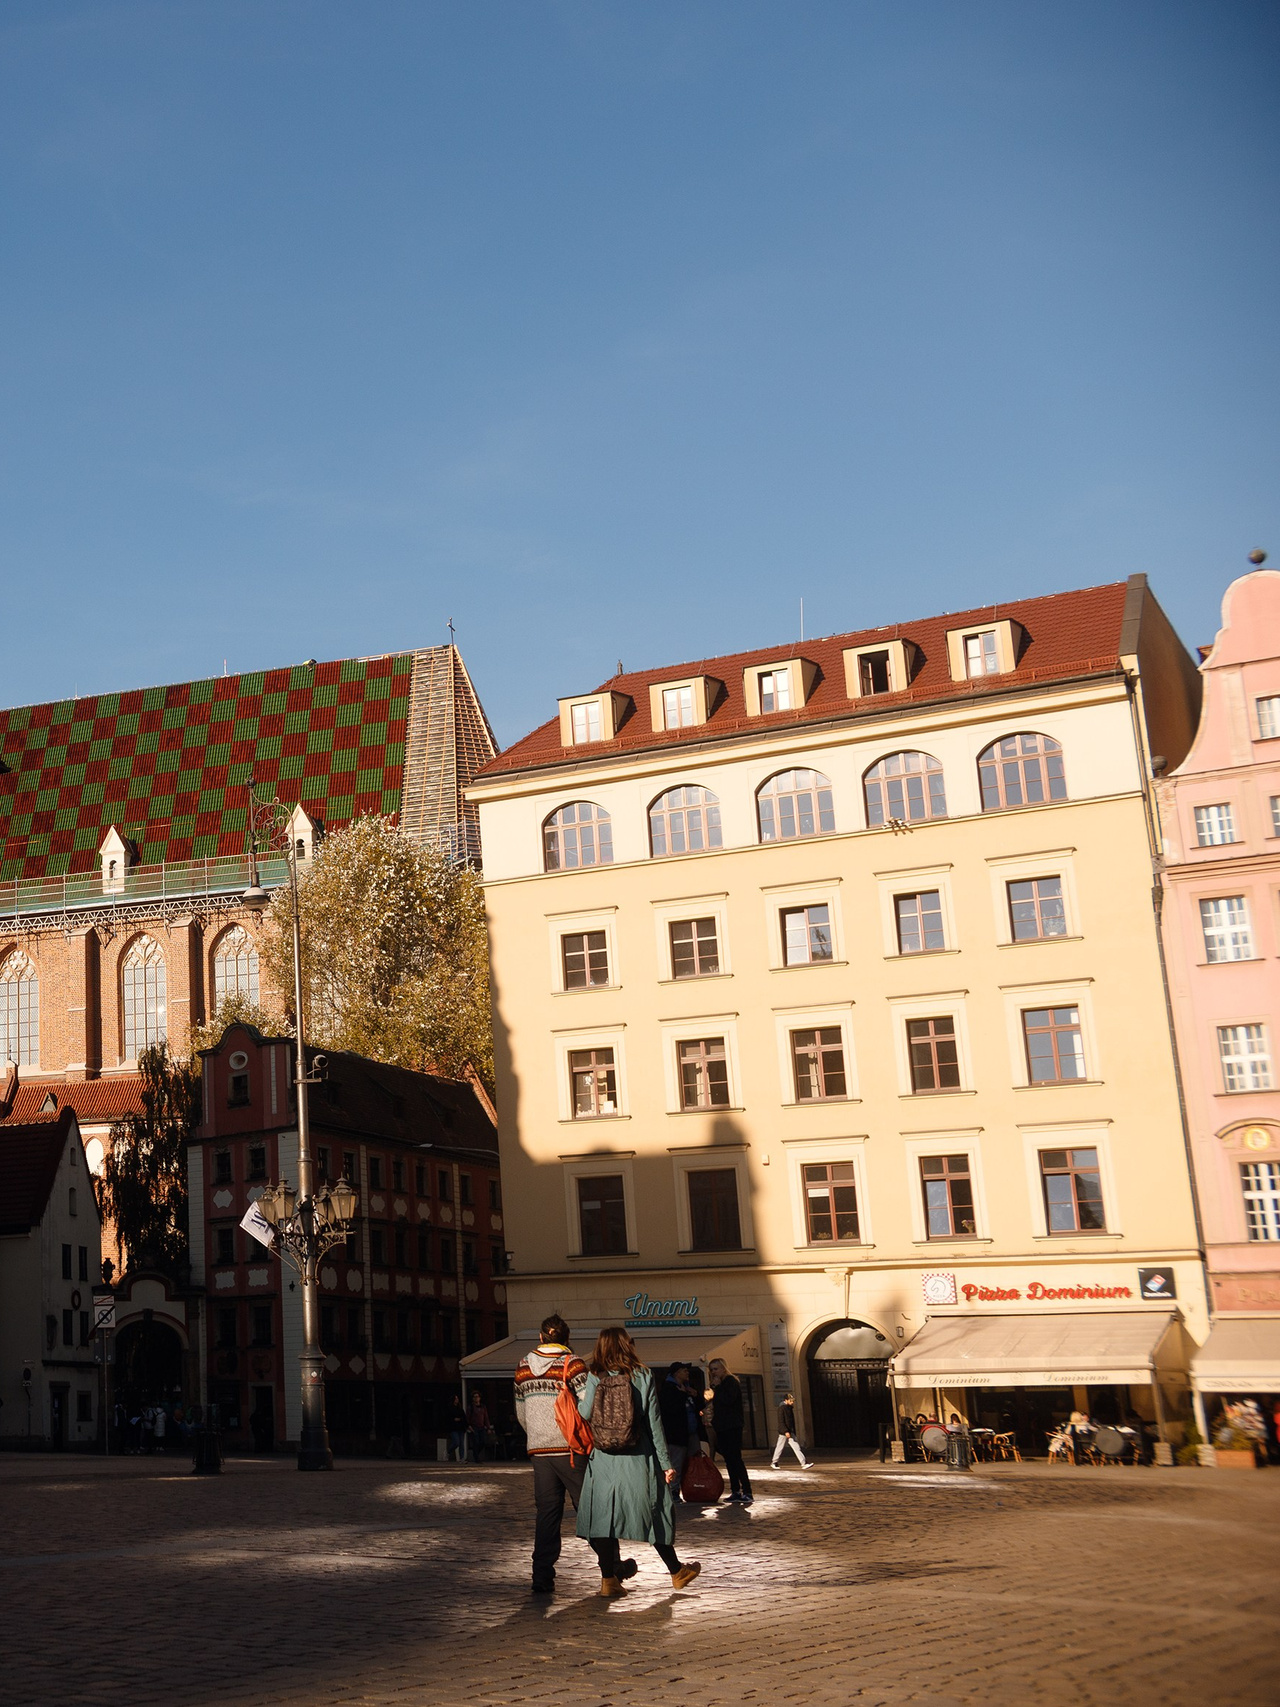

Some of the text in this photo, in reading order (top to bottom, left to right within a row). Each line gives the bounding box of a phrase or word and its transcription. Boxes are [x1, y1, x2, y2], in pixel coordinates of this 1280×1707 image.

[961, 1282, 1133, 1301] Pizza Dominium
[624, 1292, 699, 1318] Umami
[928, 1372, 1109, 1385] Dominium Dominium
